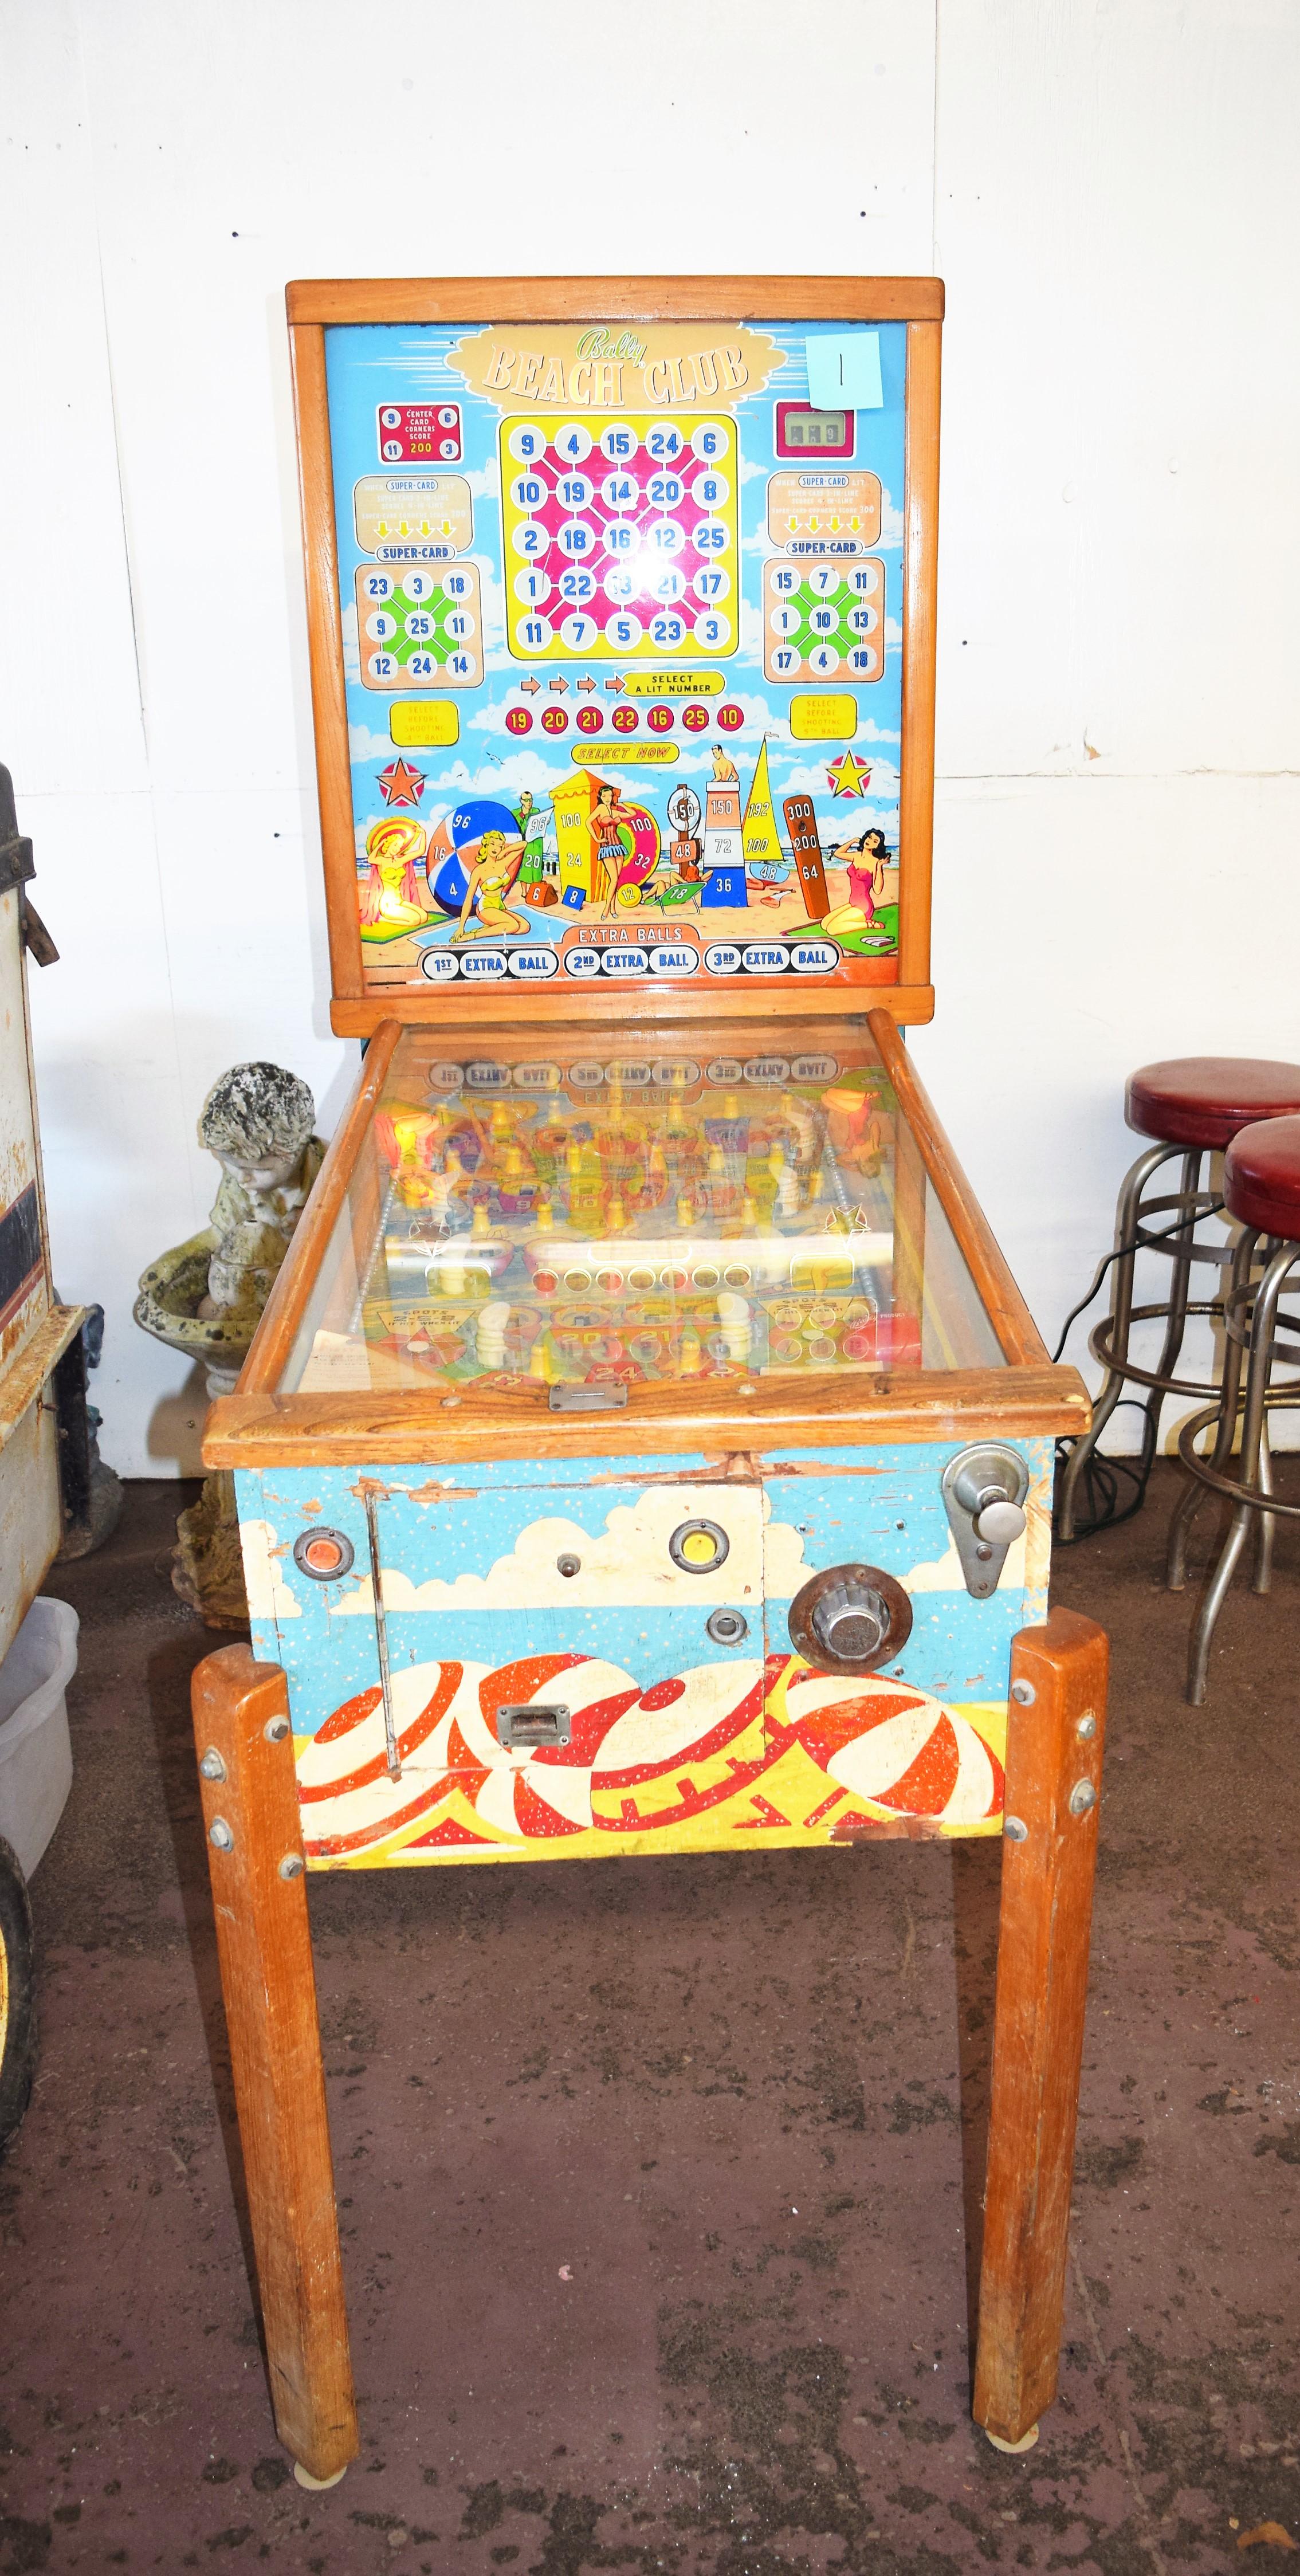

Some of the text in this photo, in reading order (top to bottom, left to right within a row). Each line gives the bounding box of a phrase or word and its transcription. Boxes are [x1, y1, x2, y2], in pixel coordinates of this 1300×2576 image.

[576, 328, 645, 371] Bally
[482, 344, 748, 406] BEACH CLUB
[388, 413, 450, 423] 9 6
[388, 443, 453, 455] 11 200 3
[522, 434, 716, 454] 9 4 15 24 6
[803, 477, 846, 485] SUPER-CARD
[518, 481, 716, 502] 10 19 14 20 8
[525, 529, 724, 551] 2 18 16 12 25
[383, 548, 448, 558] SUPER-CARD
[792, 543, 856, 553] SUPER-CARD
[370, 577, 464, 594] 23 3 18
[528, 576, 536, 596] 1
[564, 576, 591, 595] 22
[657, 575, 678, 594] 21
[701, 575, 721, 594] 17
[778, 572, 866, 588] 15 7 11
[376, 617, 464, 634] 9 25 11
[782, 612, 868, 627] 1 10 13
[526, 621, 717, 643] 11 7 5 23 3
[376, 657, 468, 674] 12 24 14
[778, 651, 867, 668] 17 4 18
[652, 675, 693, 683] SELECT
[669, 685, 710, 693] NUMBER
[511, 710, 737, 727] 19 20 21 22 16 25 10
[578, 748, 670, 759] SELECT NOW
[673, 806, 694, 819] 150
[712, 800, 733, 814] 150
[749, 803, 769, 816] 192
[788, 803, 811, 820] 300
[453, 814, 471, 828] 96
[530, 816, 545, 833] 96
[561, 814, 581, 827] 100
[631, 818, 652, 832] 100
[715, 839, 731, 853] 72
[747, 839, 768, 853] 100
[795, 835, 816, 851] 200
[434, 847, 445, 861] 16
[675, 845, 691, 858] 48
[524, 854, 539, 867] 20
[567, 854, 582, 866] 24
[634, 854, 651, 869] 32
[760, 867, 777, 880] 48
[802, 867, 818, 879] 64
[450, 883, 457, 896] 4
[716, 878, 732, 892] 36
[533, 888, 540, 900] 6
[570, 891, 578, 903] 8
[622, 889, 634, 901] 12
[669, 888, 687, 898] 18
[578, 928, 682, 943] EXTRA BALLS
[435, 951, 828, 972] 1ST EXTRA BALL 2ND EXTRA BALL 3RD EXTRA BALL
[516, 1201, 531, 1209] 9
[561, 1333, 601, 1344] 20
[641, 1331, 670, 1341] 21
[595, 1367, 637, 1380] 24
